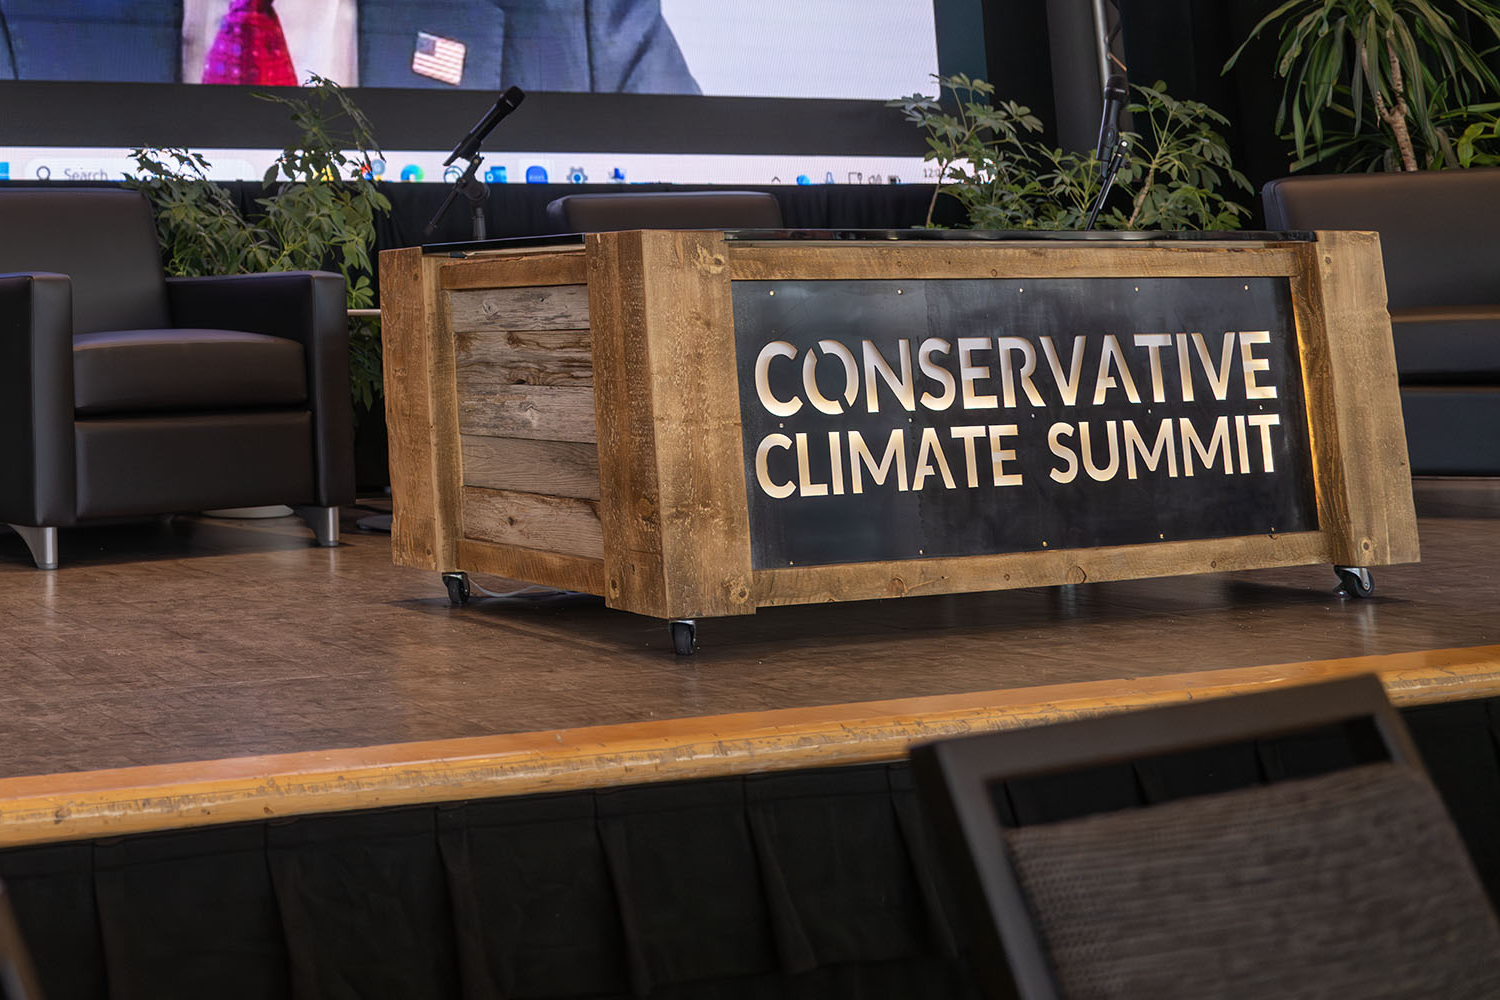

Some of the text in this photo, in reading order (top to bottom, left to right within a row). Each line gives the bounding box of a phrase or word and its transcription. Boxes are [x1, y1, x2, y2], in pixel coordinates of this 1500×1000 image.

[63, 168, 108, 181] Search
[755, 331, 1278, 416] CONSERVATIVE
[755, 414, 1281, 499] CLIMATE SUMMIT
